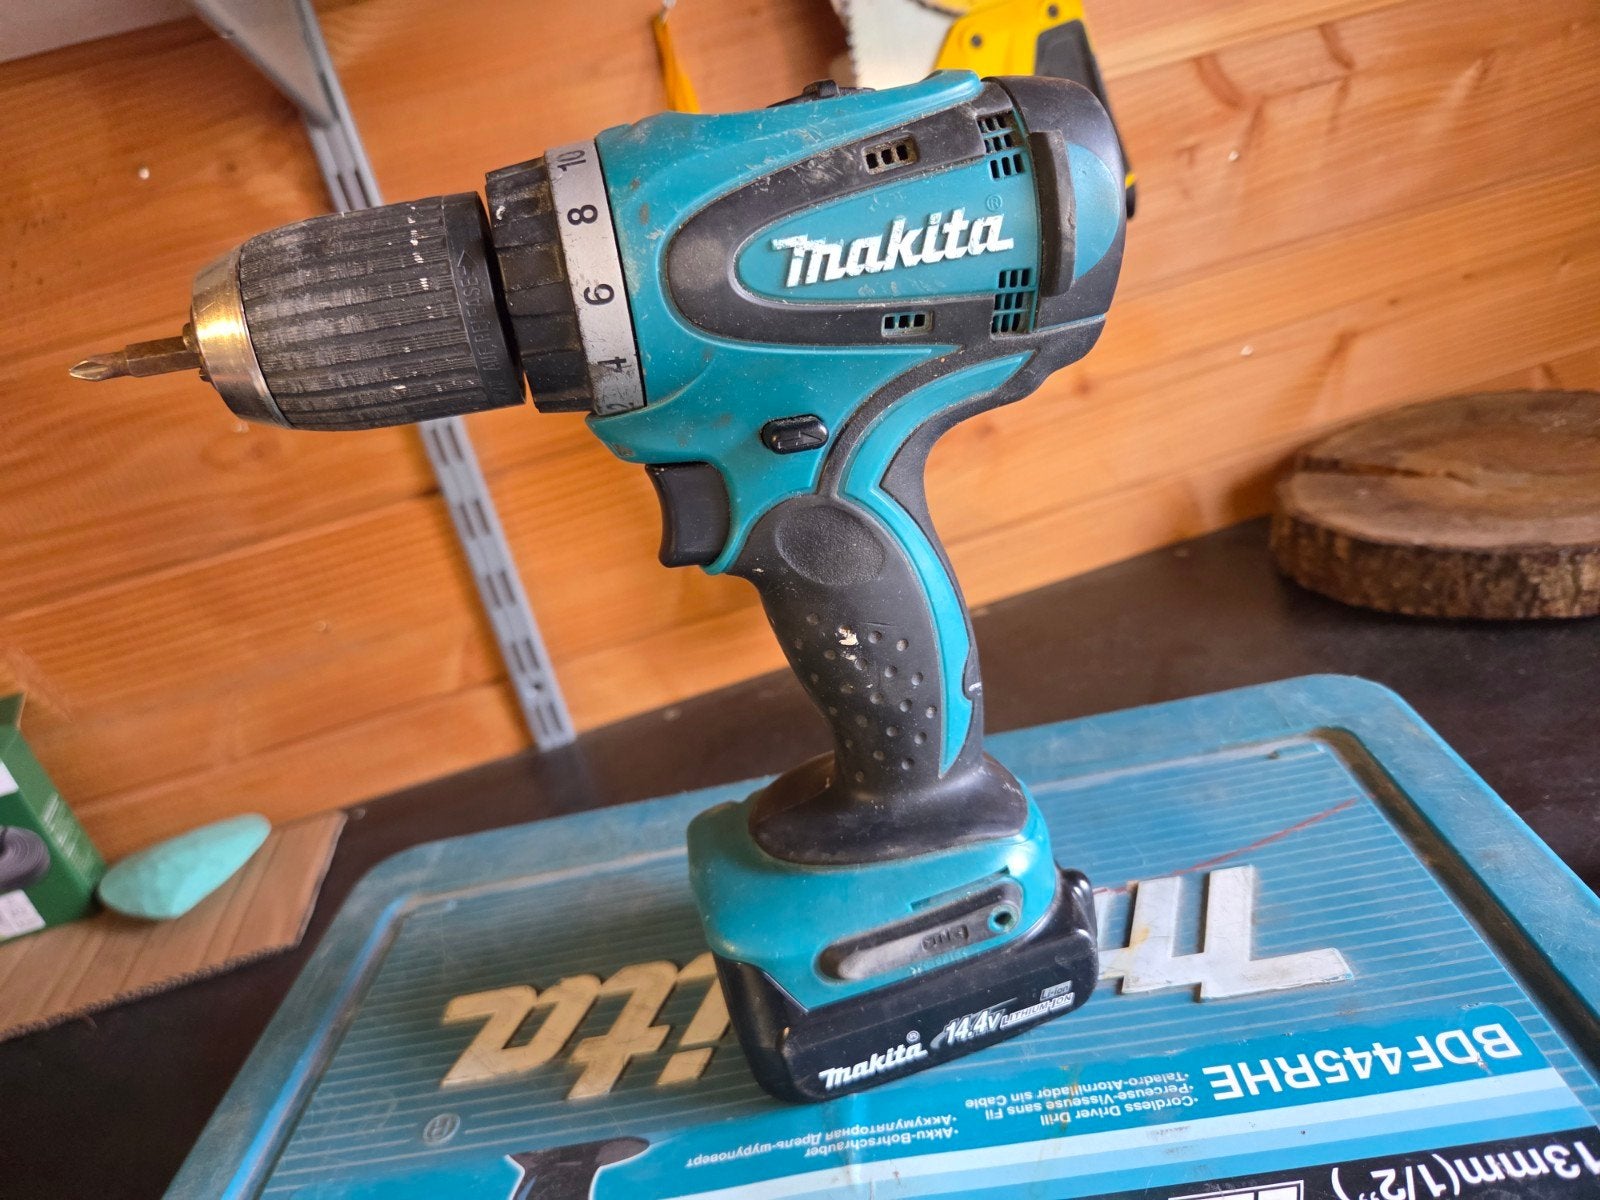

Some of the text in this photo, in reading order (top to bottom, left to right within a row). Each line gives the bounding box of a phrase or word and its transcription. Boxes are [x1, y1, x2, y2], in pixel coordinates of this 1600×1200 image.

[567, 204, 598, 226] 8
[772, 209, 1015, 287] makita
[583, 283, 615, 306] 6
[597, 356, 627, 373] 4
[818, 1041, 928, 1091] makita
[1000, 992, 1075, 1028] LITHIUM-ION
[1201, 1023, 1523, 1101] BDF445RHE
[965, 1094, 1006, 1109] Cable
[1007, 1102, 1042, 1114] sans
[985, 1107, 1003, 1121] Fil
[1040, 1110, 1071, 1126] Drill
[1075, 1104, 1121, 1119] Driver
